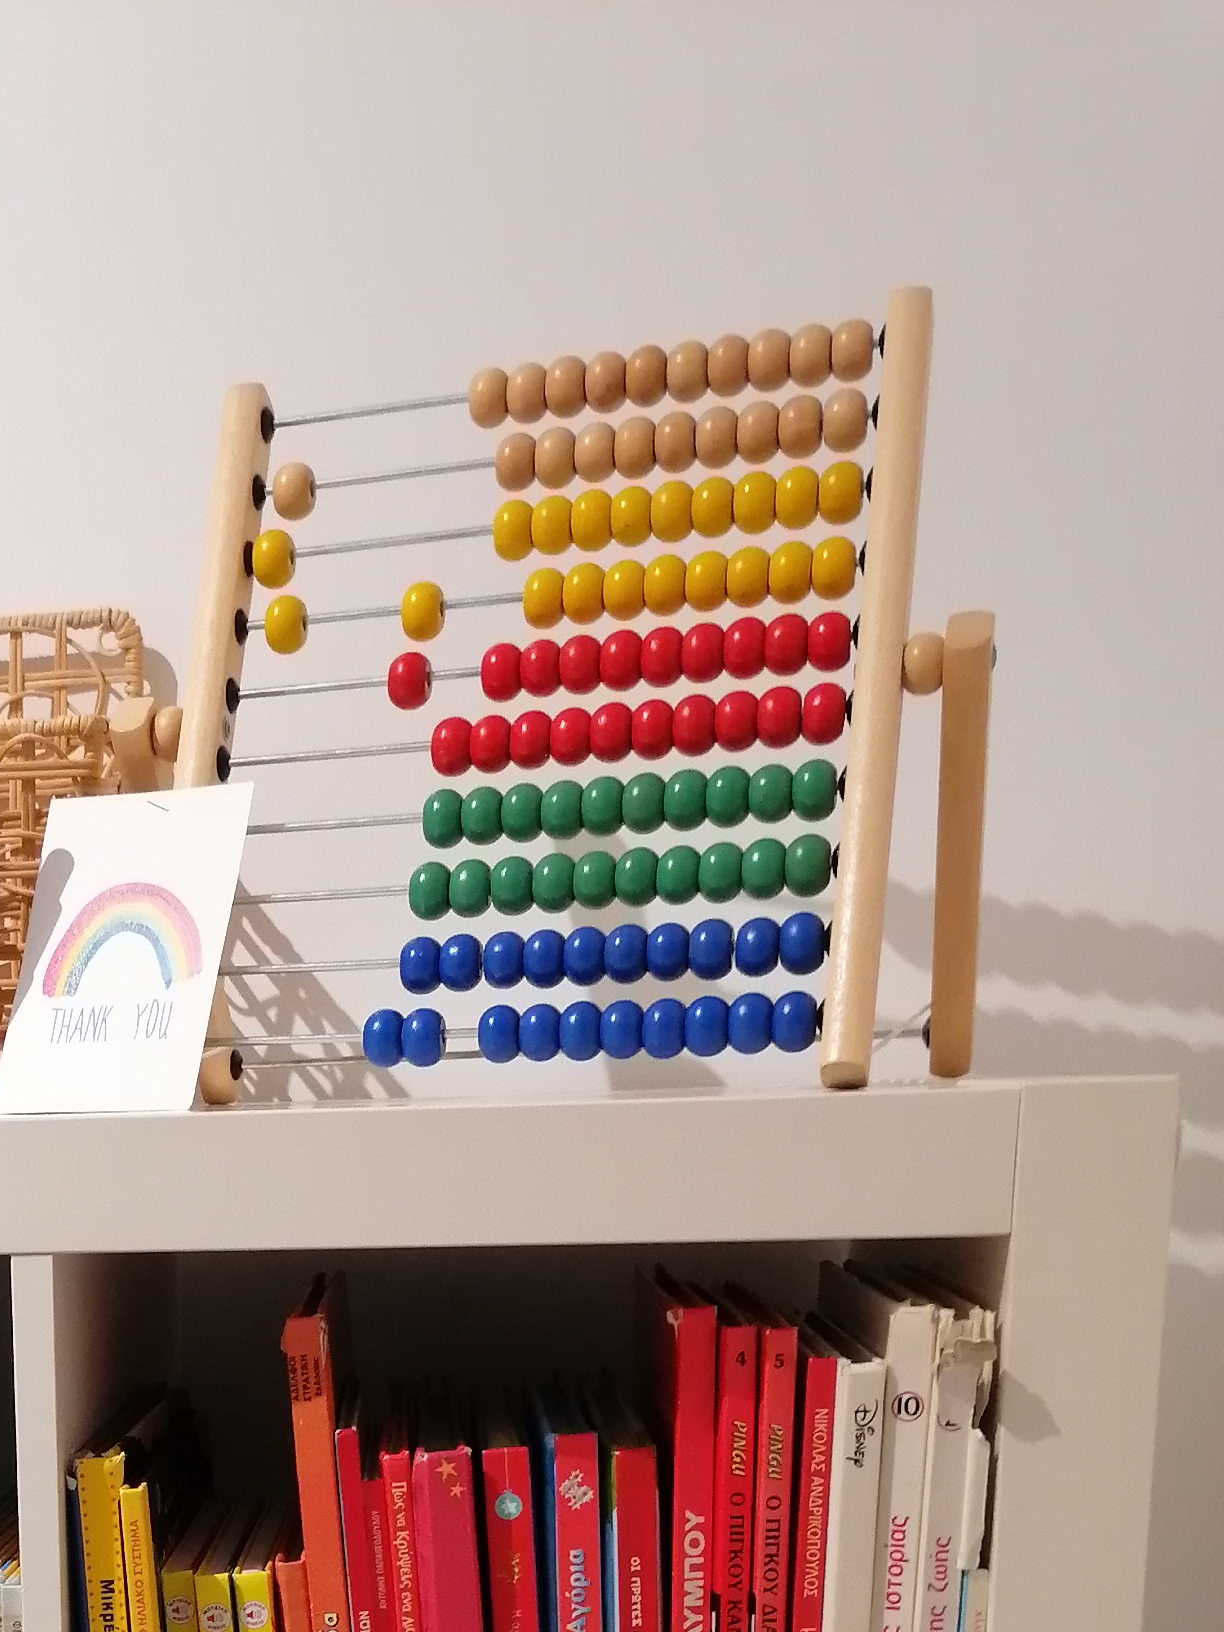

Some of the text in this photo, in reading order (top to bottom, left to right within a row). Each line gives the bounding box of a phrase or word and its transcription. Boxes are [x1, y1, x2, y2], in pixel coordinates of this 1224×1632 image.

[50, 999, 173, 1044] THANK YOU
[896, 1396, 920, 1416] 10
[810, 1408, 829, 1472] ΝΙΚΟΛΑΣ
[883, 1515, 909, 1610] ιστορίας
[927, 1536, 951, 1593] ζωής
